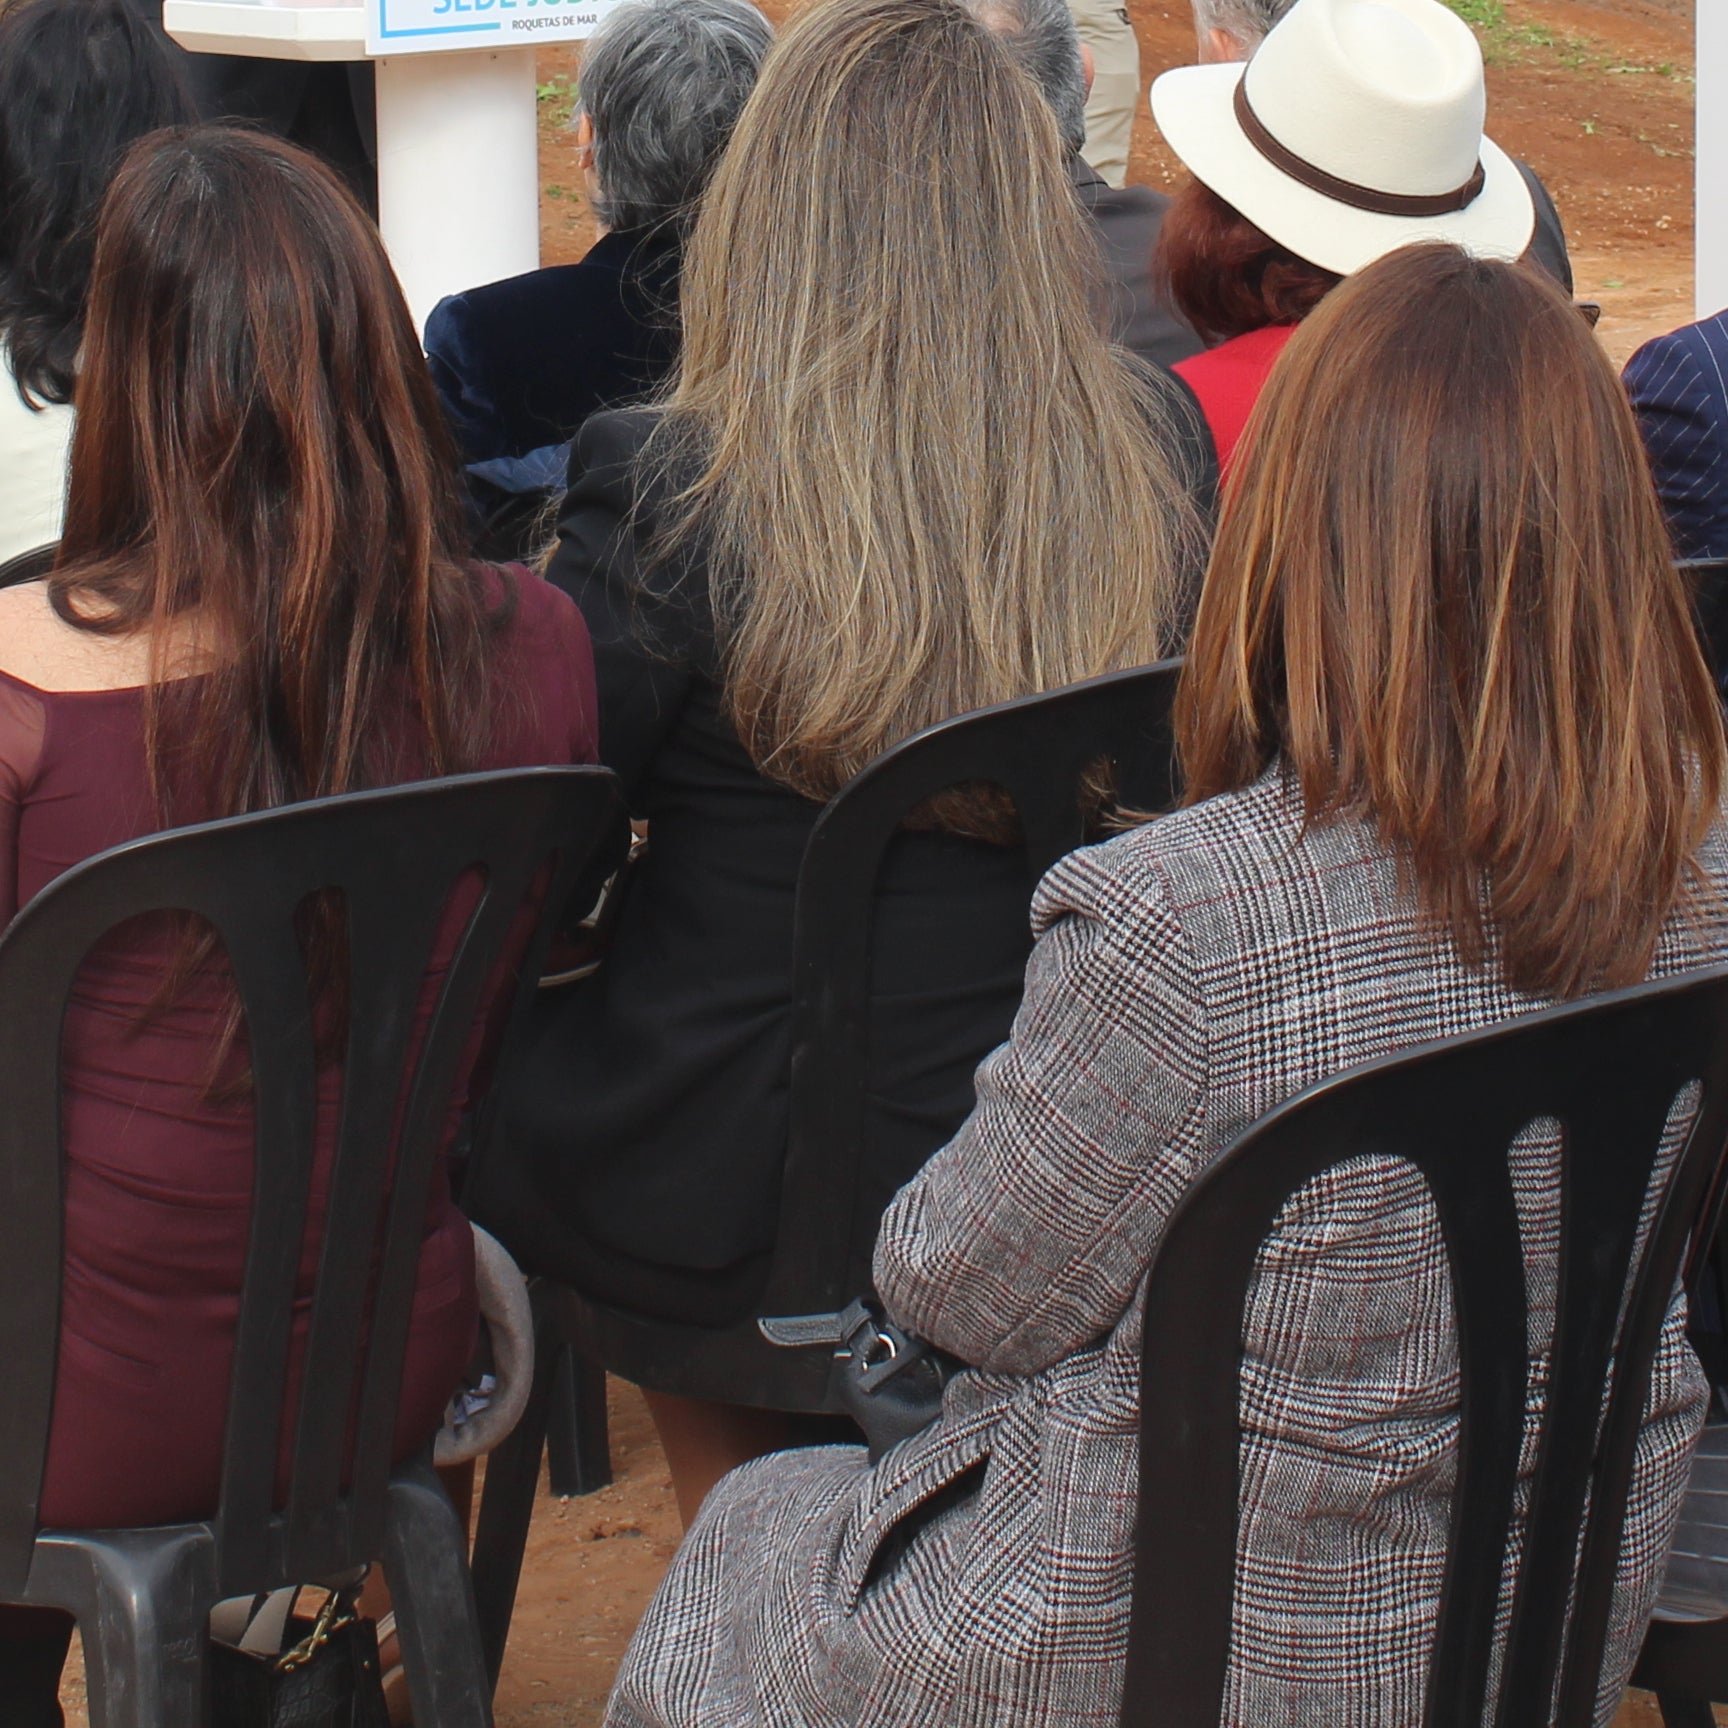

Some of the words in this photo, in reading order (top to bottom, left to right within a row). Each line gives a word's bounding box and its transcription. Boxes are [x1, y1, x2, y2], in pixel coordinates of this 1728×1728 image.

[511, 17, 560, 31] ROQUETAS
[562, 16, 576, 26] DE
[577, 14, 598, 25] MAR
